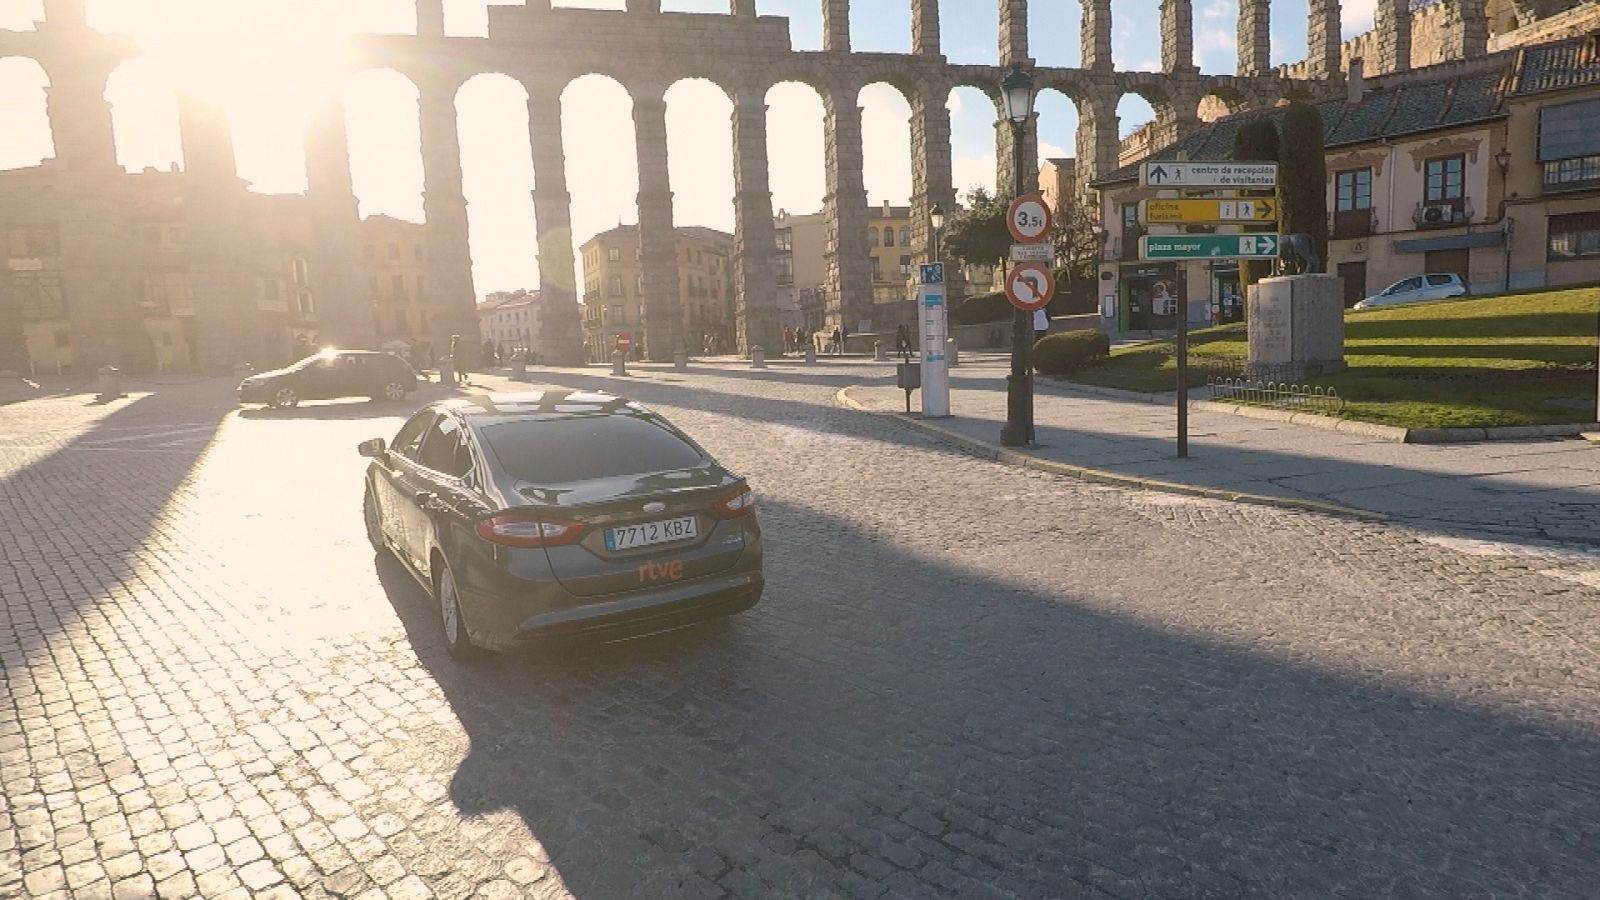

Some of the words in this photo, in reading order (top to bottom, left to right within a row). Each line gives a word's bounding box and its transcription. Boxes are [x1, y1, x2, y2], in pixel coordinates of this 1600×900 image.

[1191, 166, 1219, 174] centro
[1221, 166, 1232, 174] de
[1234, 166, 1275, 176] recepción
[1220, 176, 1231, 184] de
[1232, 176, 1274, 184] visitantes
[1149, 203, 1179, 211] oficina
[1148, 243, 1172, 252] plaza
[1174, 243, 1201, 253] mayor
[617, 524, 658, 546] 7712
[663, 519, 692, 538] KBZ
[639, 560, 683, 582] rtve
